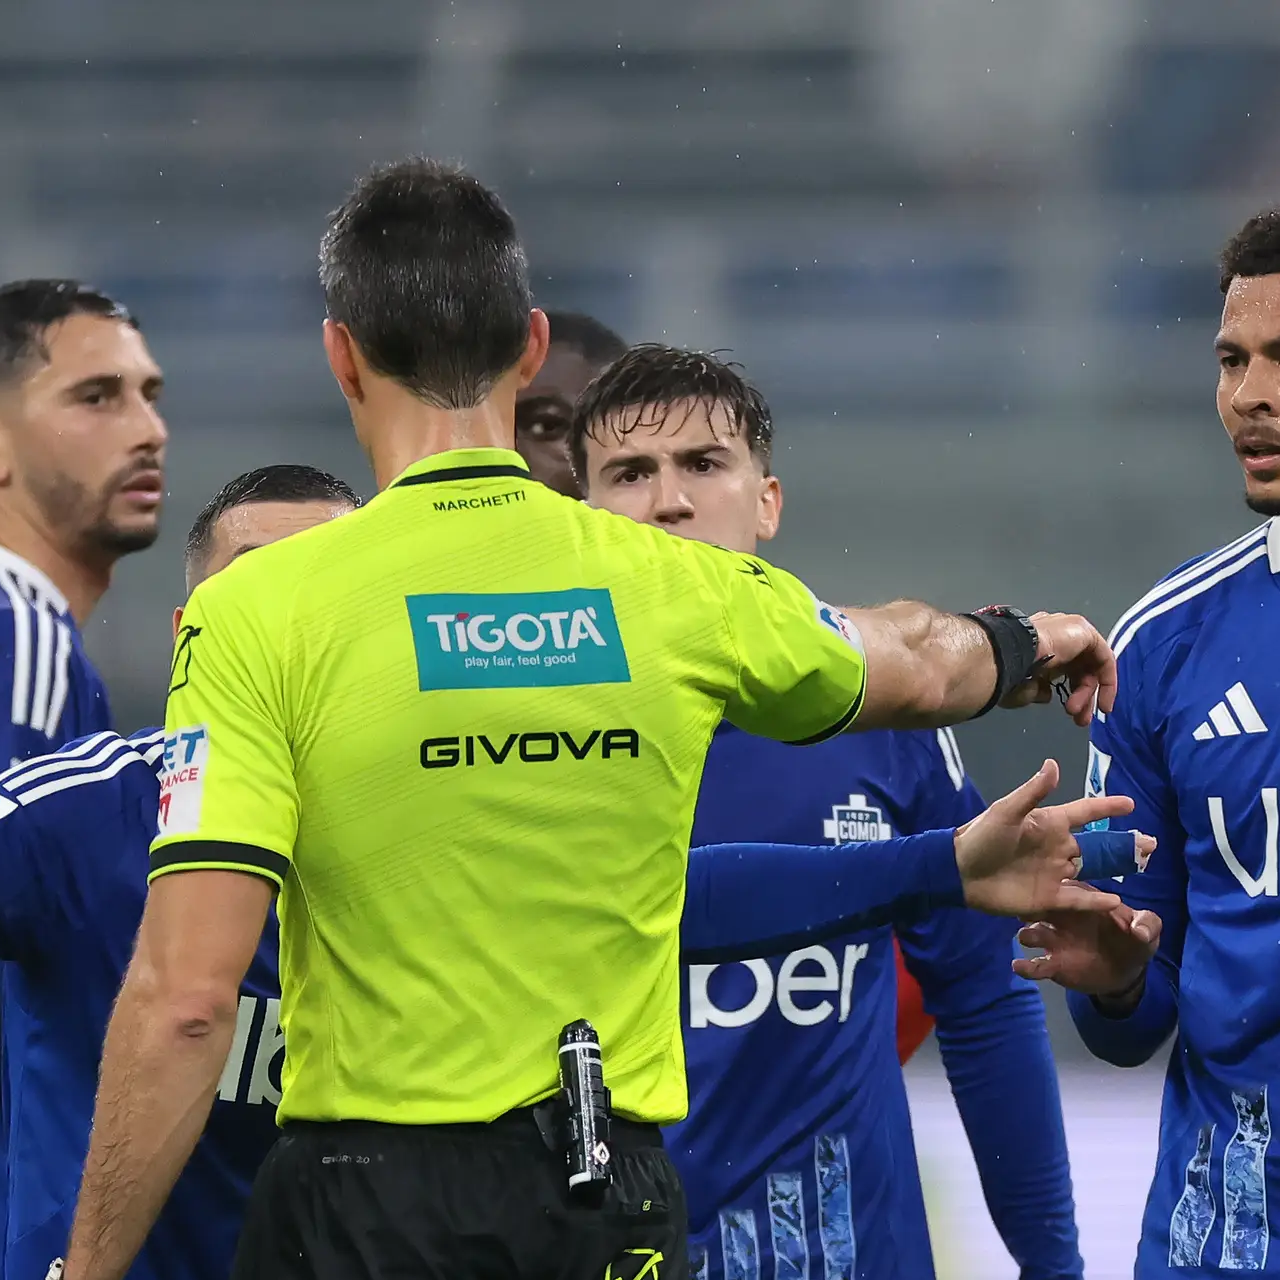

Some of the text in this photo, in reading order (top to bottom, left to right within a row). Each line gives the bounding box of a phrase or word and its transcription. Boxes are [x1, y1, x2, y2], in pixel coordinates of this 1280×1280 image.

[432, 490, 527, 512] MARCHETTI
[464, 652, 577, 669] play fair, feel good
[419, 728, 640, 769] GIVOVA
[839, 820, 878, 842] COMO
